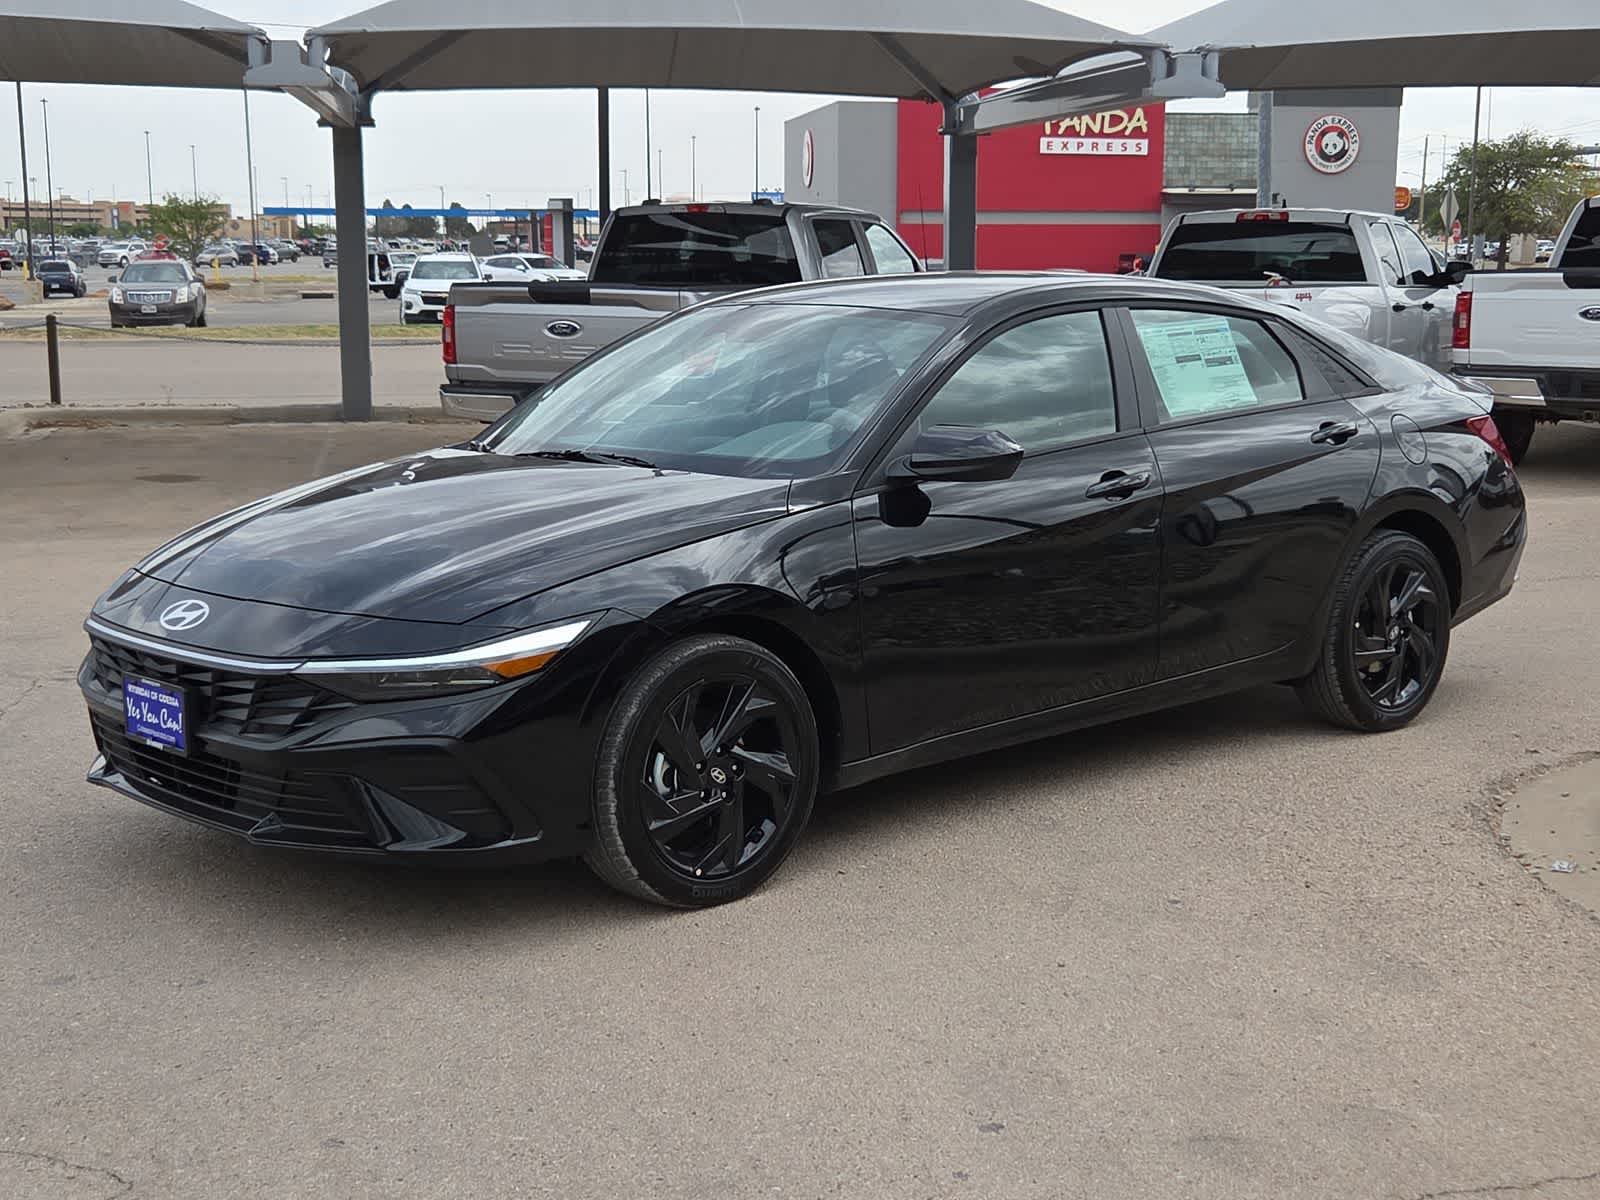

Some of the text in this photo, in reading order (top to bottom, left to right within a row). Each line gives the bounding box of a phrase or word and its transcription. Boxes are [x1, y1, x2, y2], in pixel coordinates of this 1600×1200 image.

[1307, 117, 1358, 145] PANDA EXPRESS
[1046, 140, 1143, 153] EXPRESS
[126, 696, 141, 720] Yes
[141, 701, 159, 724] You
[160, 708, 183, 734] Can!
